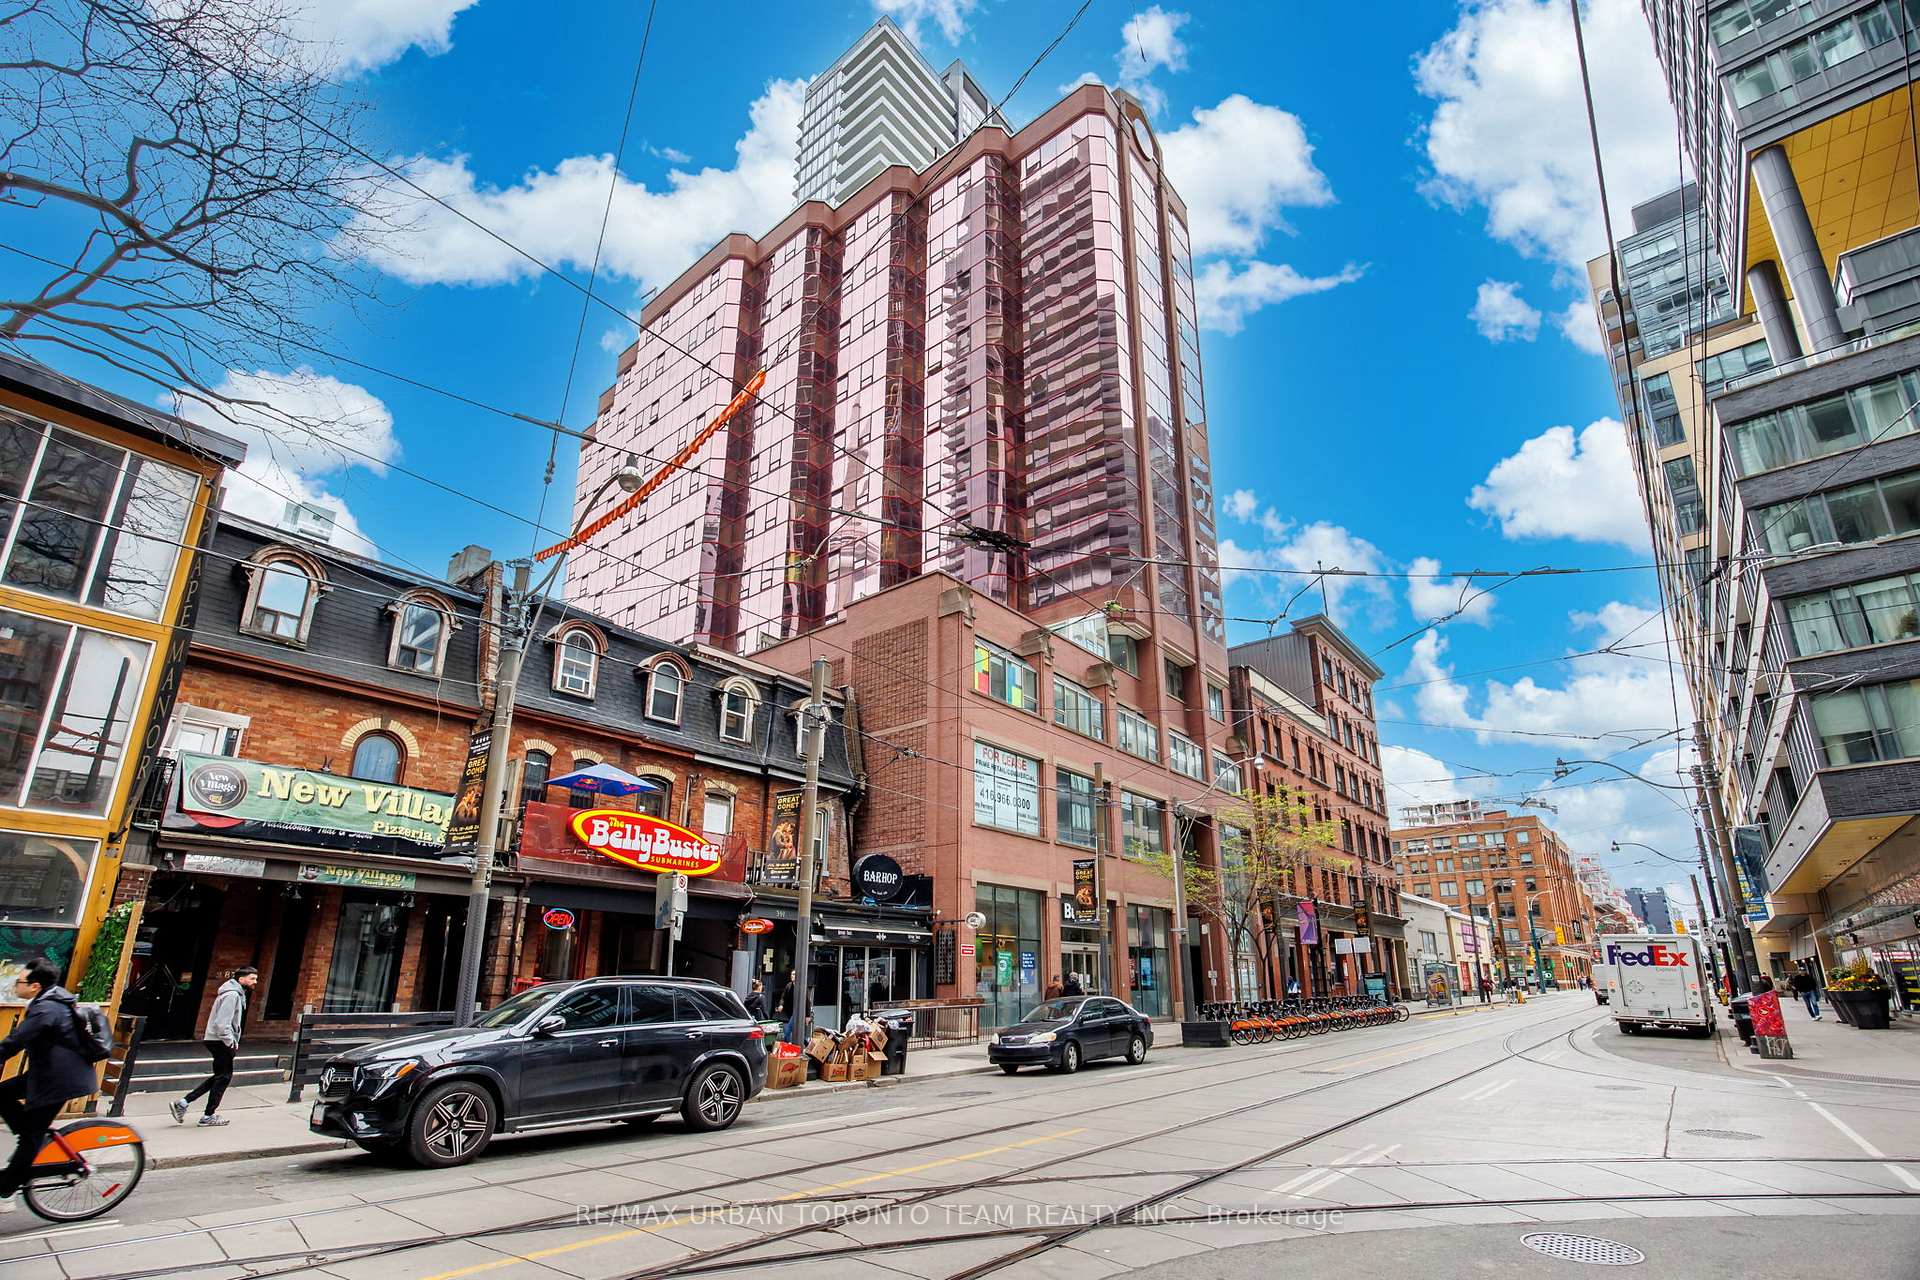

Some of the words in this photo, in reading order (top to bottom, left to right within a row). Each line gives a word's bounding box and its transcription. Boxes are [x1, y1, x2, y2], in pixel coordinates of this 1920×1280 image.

[137, 639, 184, 780] MANOR
[982, 747, 1000, 762] FOR
[1002, 753, 1027, 771] LEASE
[200, 779, 237, 792] Village
[257, 769, 351, 808] New
[777, 796, 799, 804] GREAT
[609, 816, 625, 828] The
[372, 821, 433, 842] Pizzeria
[437, 831, 446, 844] &
[650, 856, 700, 869] SUBMARINES
[325, 865, 354, 878] New
[356, 868, 402, 883] Village
[863, 869, 898, 885] BARHOP
[545, 912, 572, 927] OPEN
[1606, 945, 1689, 966] FedEx
